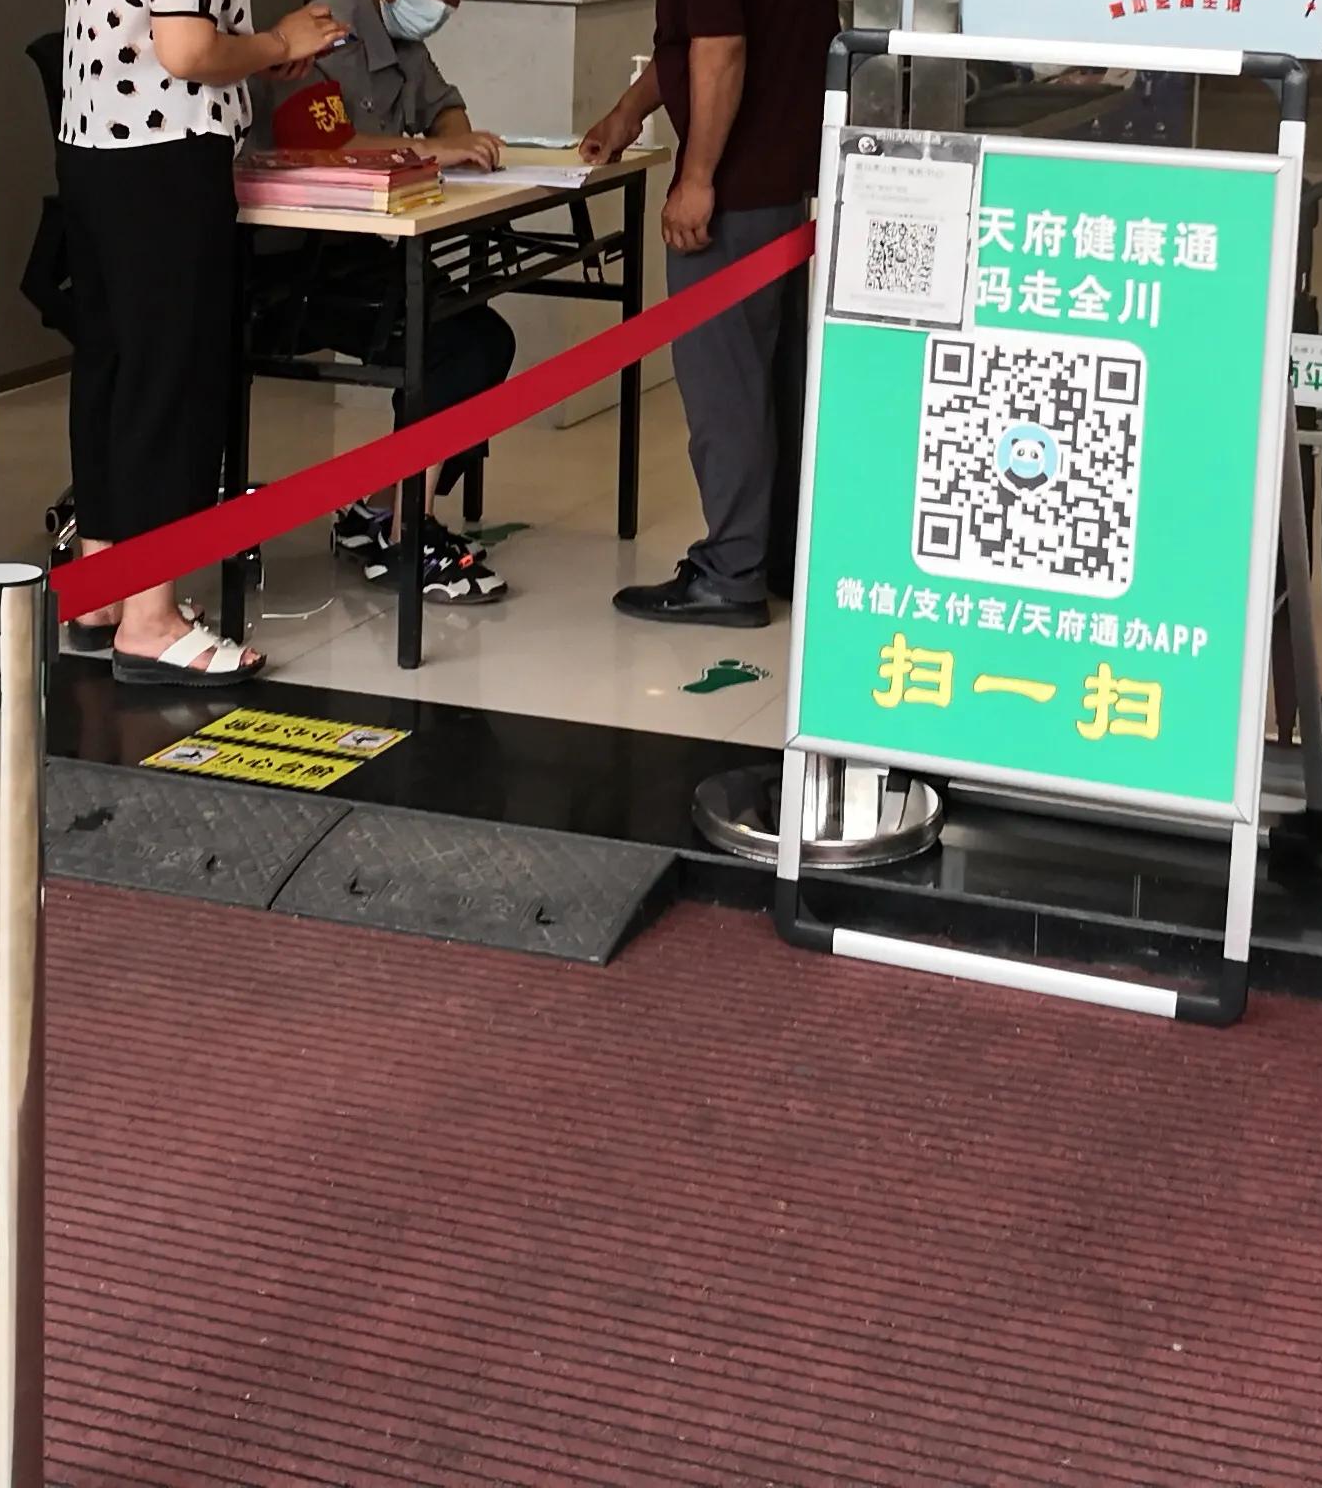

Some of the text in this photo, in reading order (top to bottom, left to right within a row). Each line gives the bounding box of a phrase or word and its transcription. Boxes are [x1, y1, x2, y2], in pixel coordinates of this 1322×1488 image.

[978, 206, 1220, 271] 天府健康通
[974, 265, 1162, 329] 码走全川
[835, 576, 1210, 658] 微信/支付宝/天府通办APP
[871, 631, 1164, 742] 扫一扫
